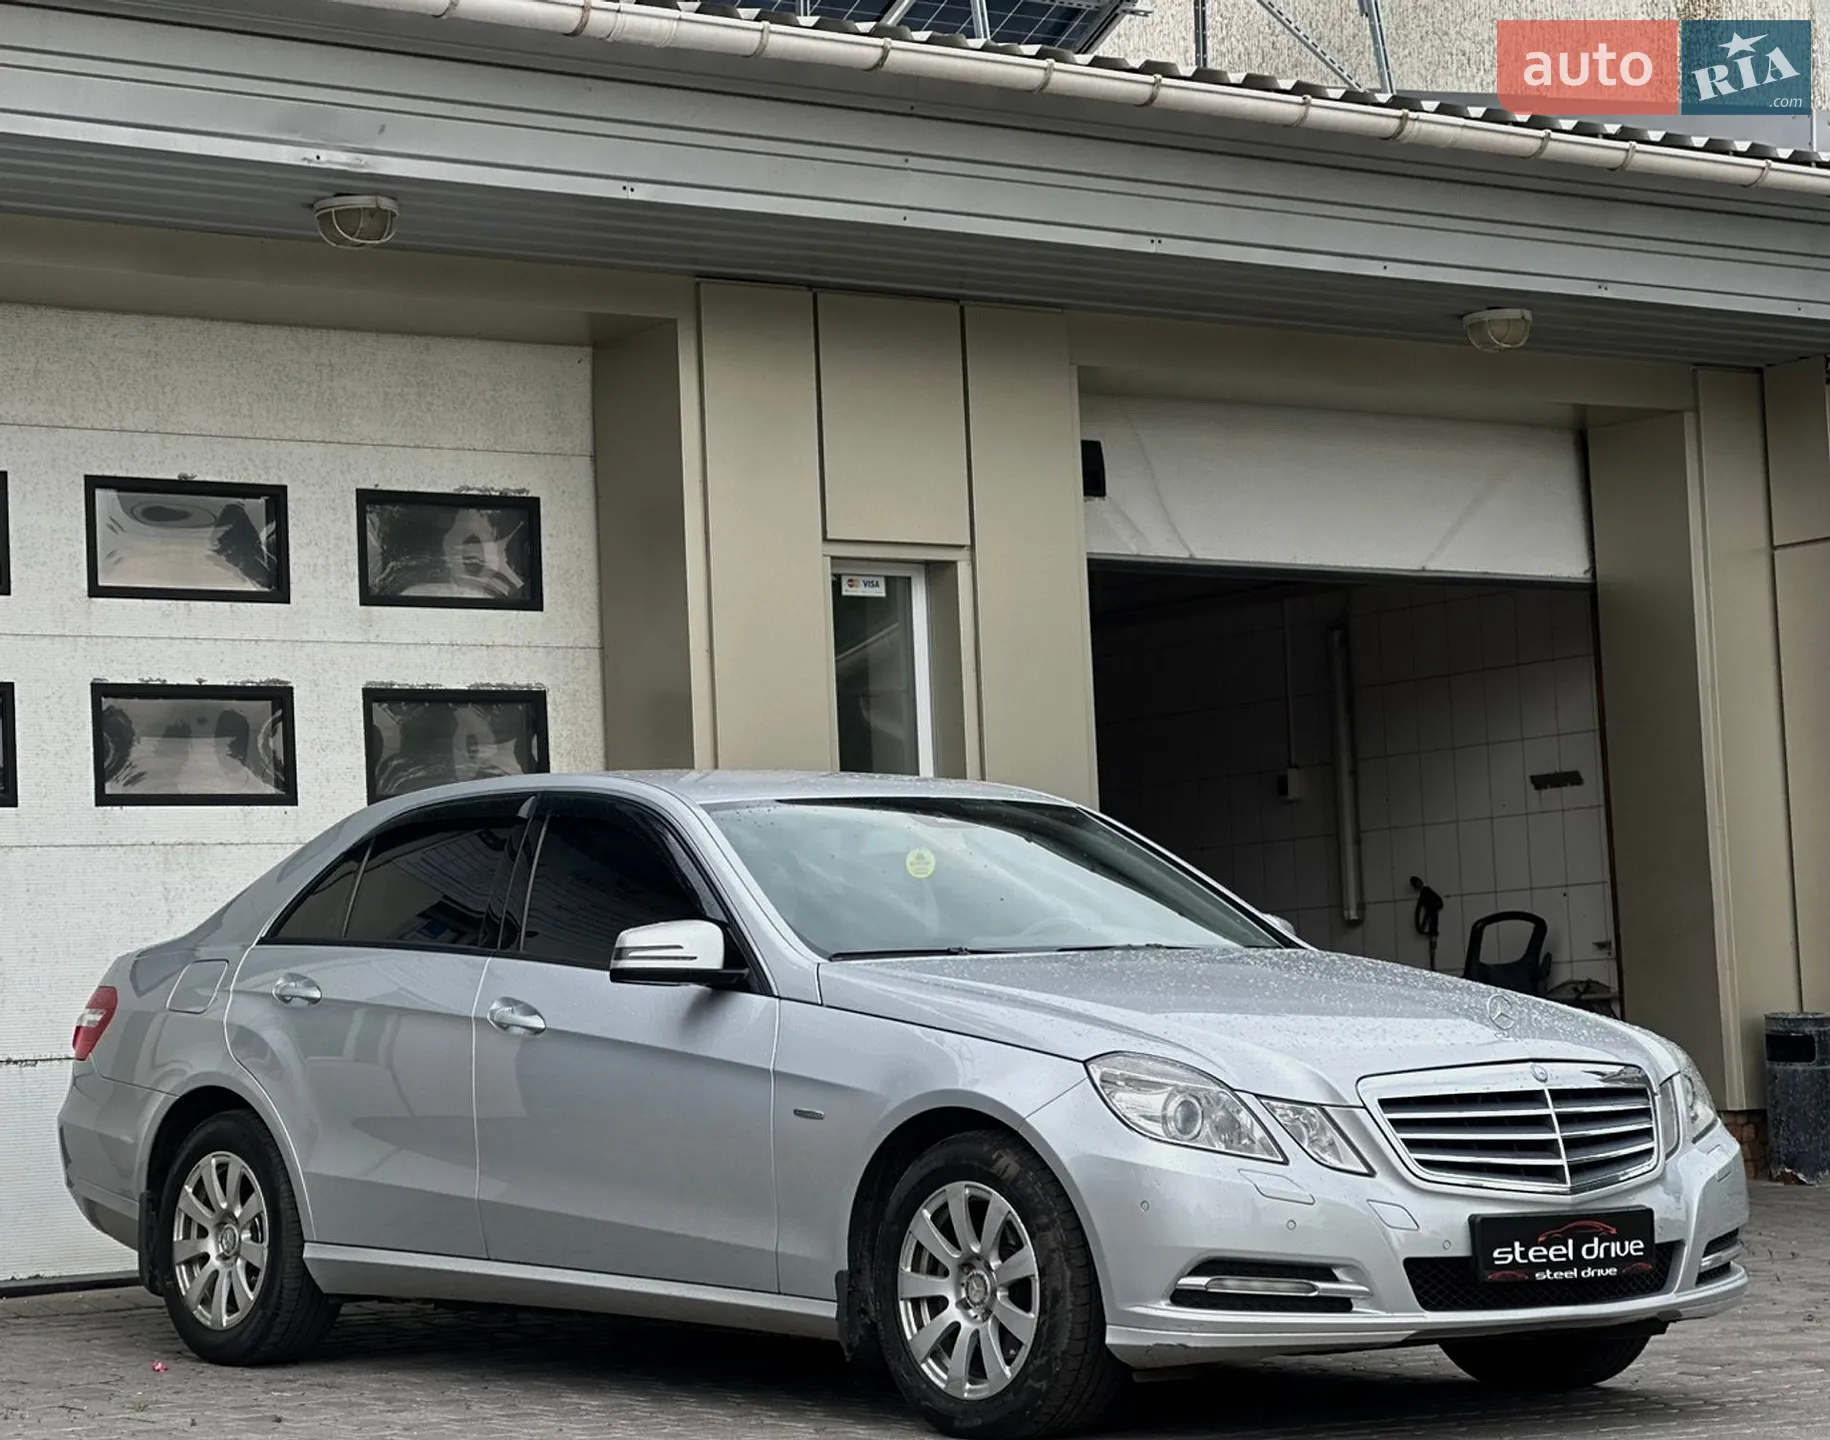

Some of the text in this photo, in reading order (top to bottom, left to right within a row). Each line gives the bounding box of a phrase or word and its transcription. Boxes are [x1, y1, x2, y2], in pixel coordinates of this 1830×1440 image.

[862, 579, 880, 588] VISA
[1492, 1236, 1645, 1265] steel drive
[1535, 1266, 1618, 1281] steel drive
